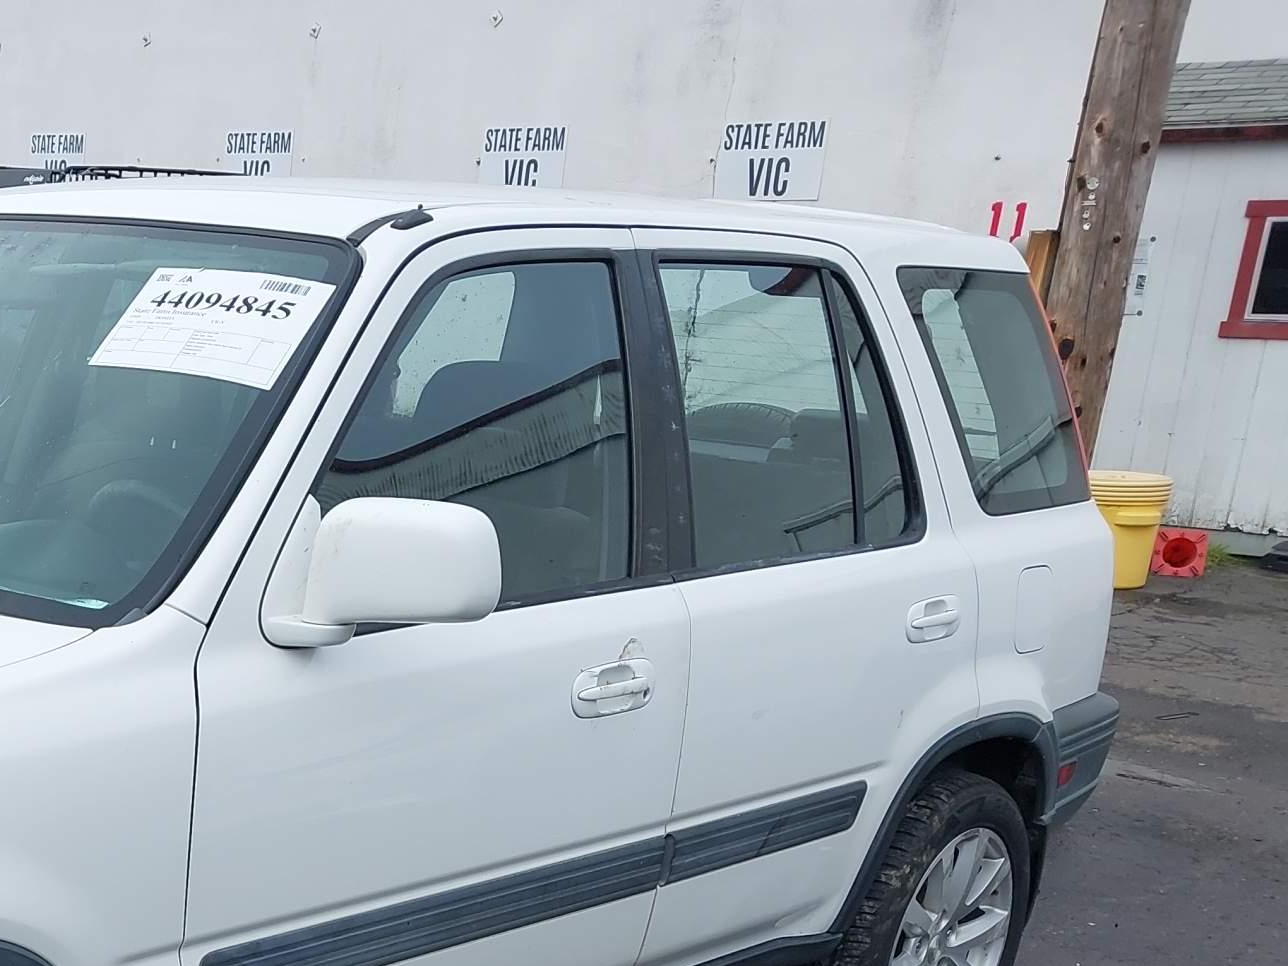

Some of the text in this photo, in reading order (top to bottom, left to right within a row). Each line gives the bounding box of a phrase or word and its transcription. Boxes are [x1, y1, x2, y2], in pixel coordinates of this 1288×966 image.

[31, 134, 84, 154] STATE FARM
[227, 131, 292, 154] STATE FARM
[485, 127, 566, 152] STATE FARM
[724, 121, 826, 150] STATE FARM
[504, 158, 538, 187] VIC
[749, 157, 790, 196] VIC
[989, 201, 1027, 242] 11
[150, 289, 297, 320] 44094845
